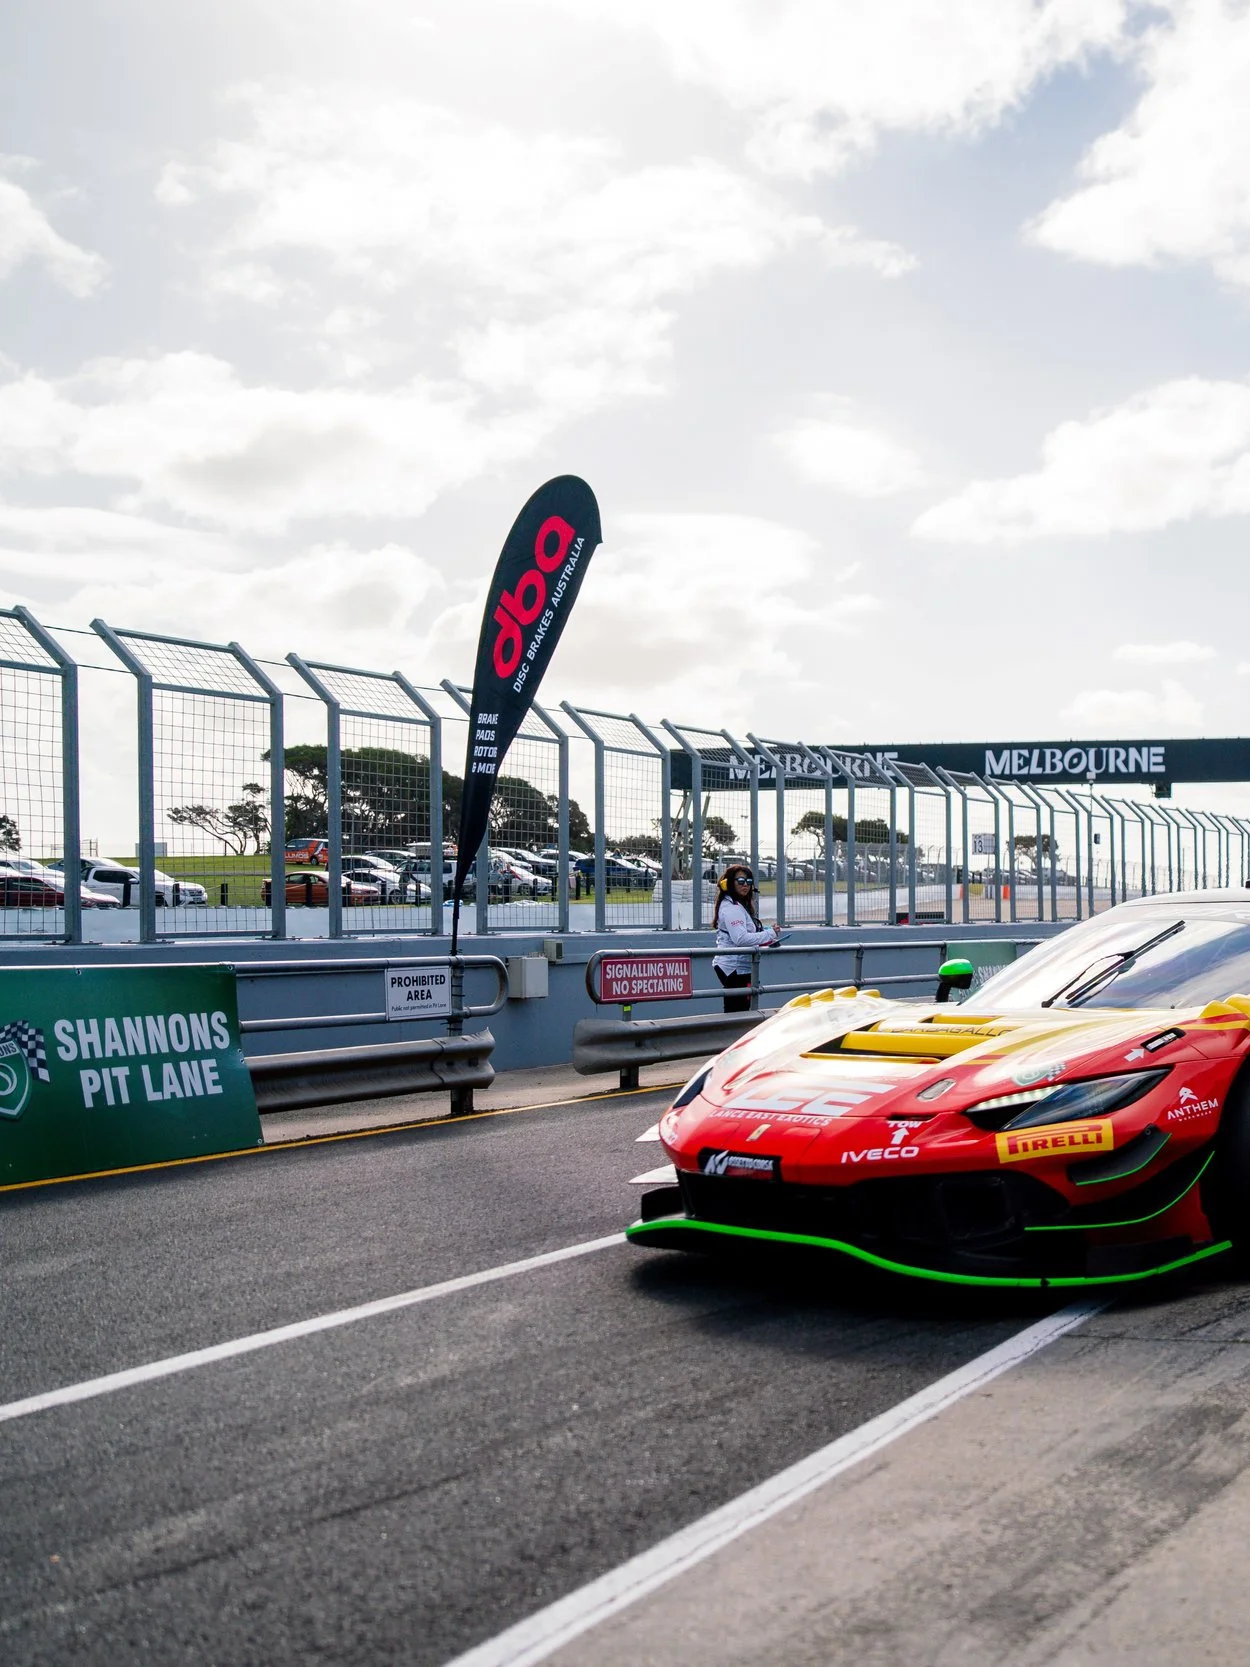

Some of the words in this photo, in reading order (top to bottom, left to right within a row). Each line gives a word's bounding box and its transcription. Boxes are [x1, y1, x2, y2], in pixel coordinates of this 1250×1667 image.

[493, 515, 576, 679] dba
[512, 663, 530, 694] DISC
[526, 608, 554, 661] BRAKES
[552, 536, 586, 607] AUSTRALIA
[475, 729, 496, 741] PADS
[729, 751, 899, 780] MEBORNE
[984, 746, 1166, 775] MELBOURNE
[606, 962, 664, 980] SIGNALLING
[665, 962, 688, 976] WALL
[390, 974, 446, 989] PROHIBITED
[612, 980, 630, 995] NO
[631, 977, 684, 995] SPECTATING
[406, 988, 433, 1002] AREA
[53, 1010, 231, 1062] SHANNONS
[79, 1065, 131, 1109] PIT
[141, 1058, 224, 1101] LANE
[709, 1108, 748, 1119] LANCE
[748, 1111, 774, 1121] EAST
[776, 1113, 833, 1127] EXOTICS
[1167, 1098, 1219, 1120] ANTHEM
[887, 1120, 924, 1128] TOW
[1006, 1124, 1103, 1156] PIRELLI
[841, 1146, 920, 1164] IVECO
